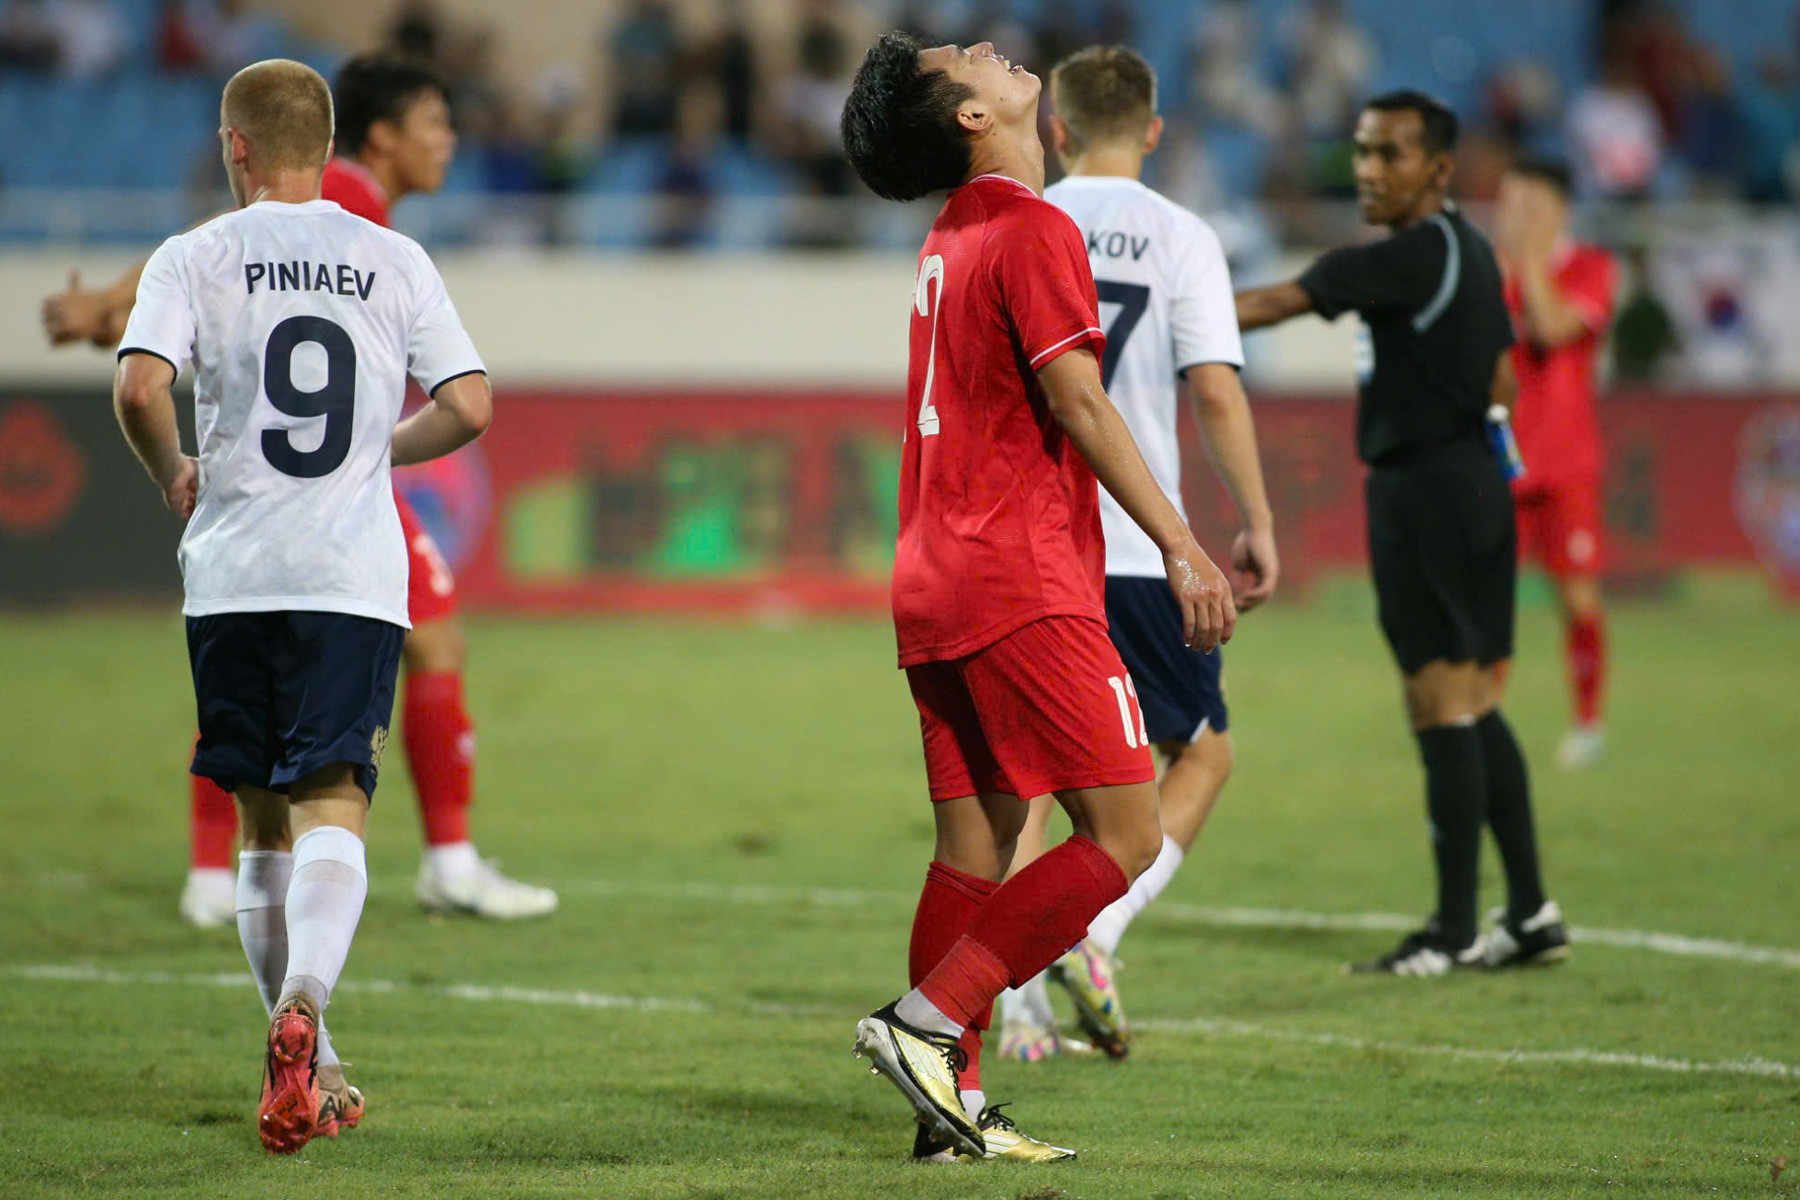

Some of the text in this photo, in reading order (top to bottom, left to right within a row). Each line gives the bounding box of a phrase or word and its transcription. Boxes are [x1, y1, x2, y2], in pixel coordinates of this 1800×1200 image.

[245, 261, 376, 301] PINIAEV
[904, 254, 944, 442] 2
[1094, 279, 1151, 395] 7
[261, 315, 357, 478] 9
